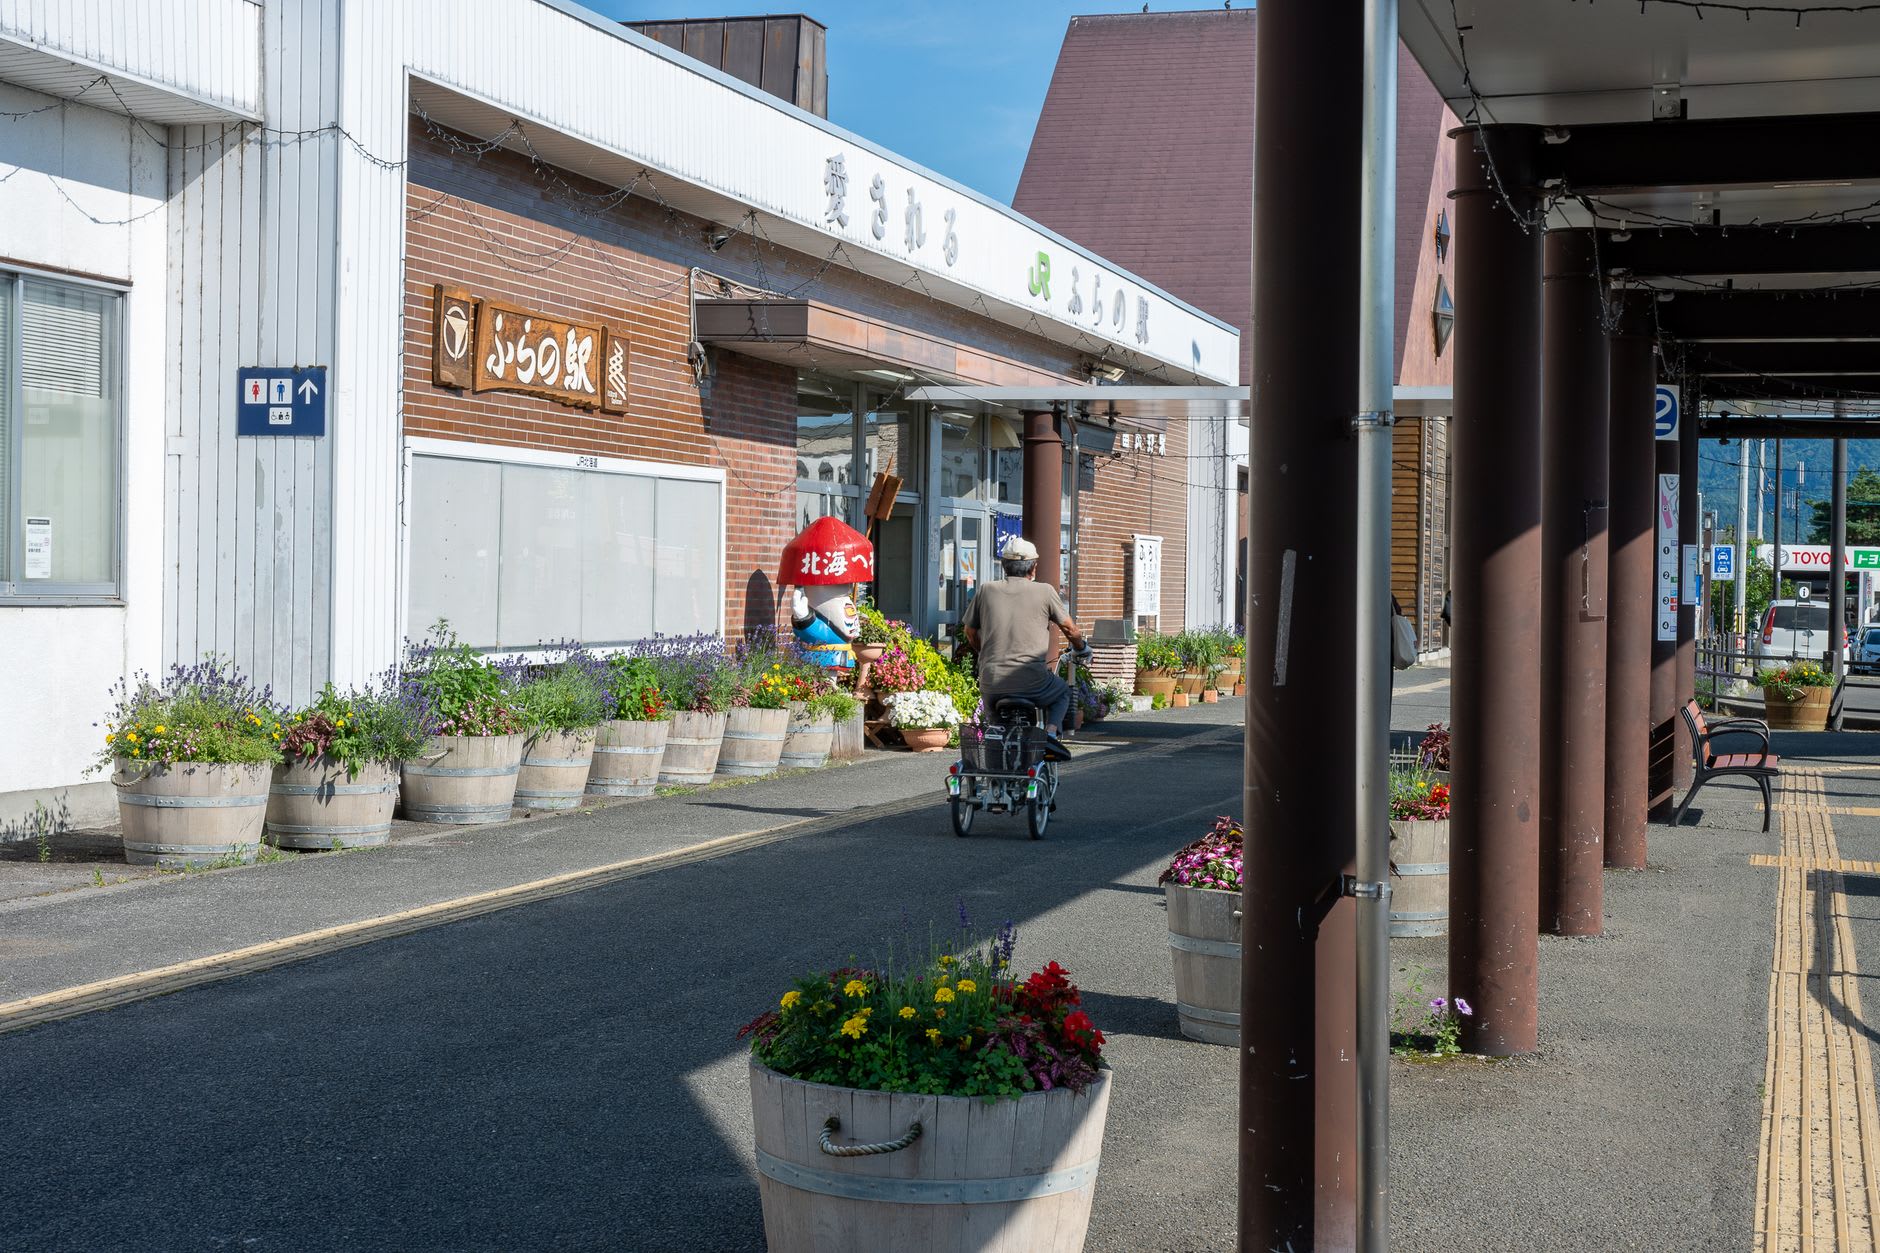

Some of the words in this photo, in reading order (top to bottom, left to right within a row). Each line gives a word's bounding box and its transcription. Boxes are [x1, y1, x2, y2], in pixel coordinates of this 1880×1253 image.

[823, 152, 960, 268] 愛される
[1028, 250, 1052, 301] JR
[1067, 265, 1150, 345] ふらの駅
[485, 313, 596, 394] ふらの駅
[1857, 554, 1880, 565] トヨ
